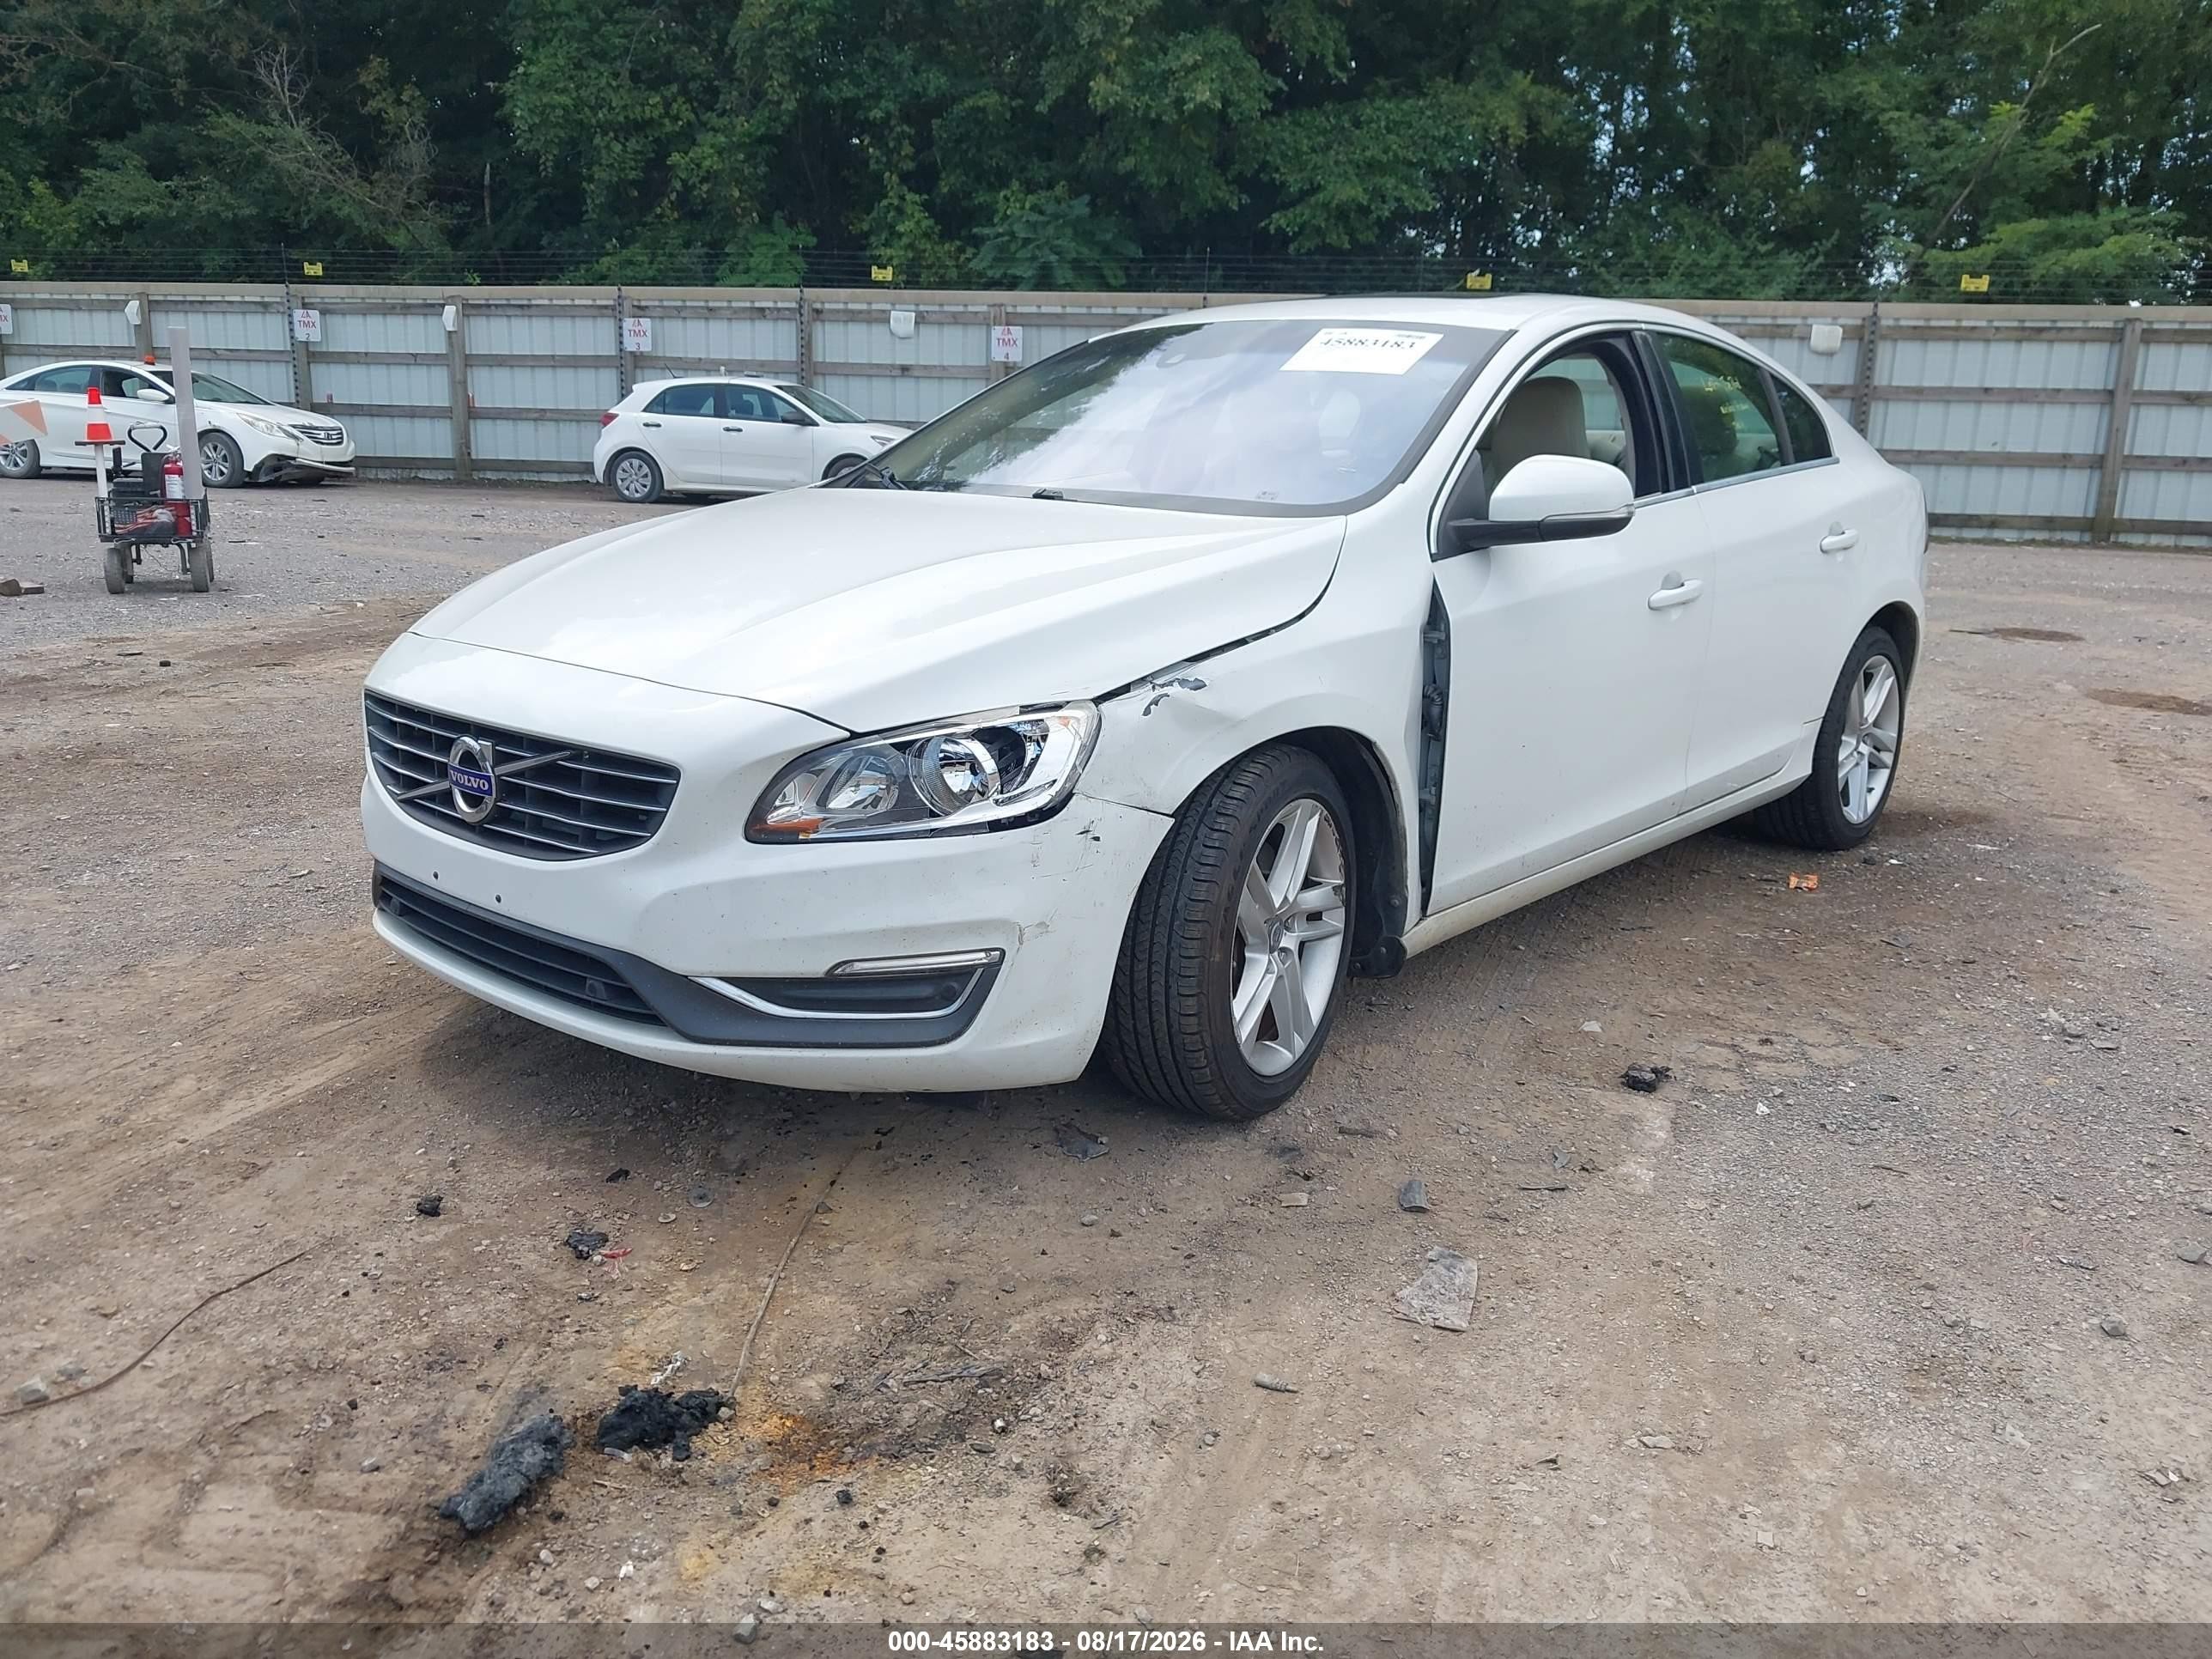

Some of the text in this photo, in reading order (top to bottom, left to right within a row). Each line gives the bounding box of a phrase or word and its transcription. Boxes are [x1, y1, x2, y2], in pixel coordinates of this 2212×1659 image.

[628, 329, 647, 337] TMX
[996, 337, 1018, 346] TMX
[450, 771, 489, 790] VOLVO
